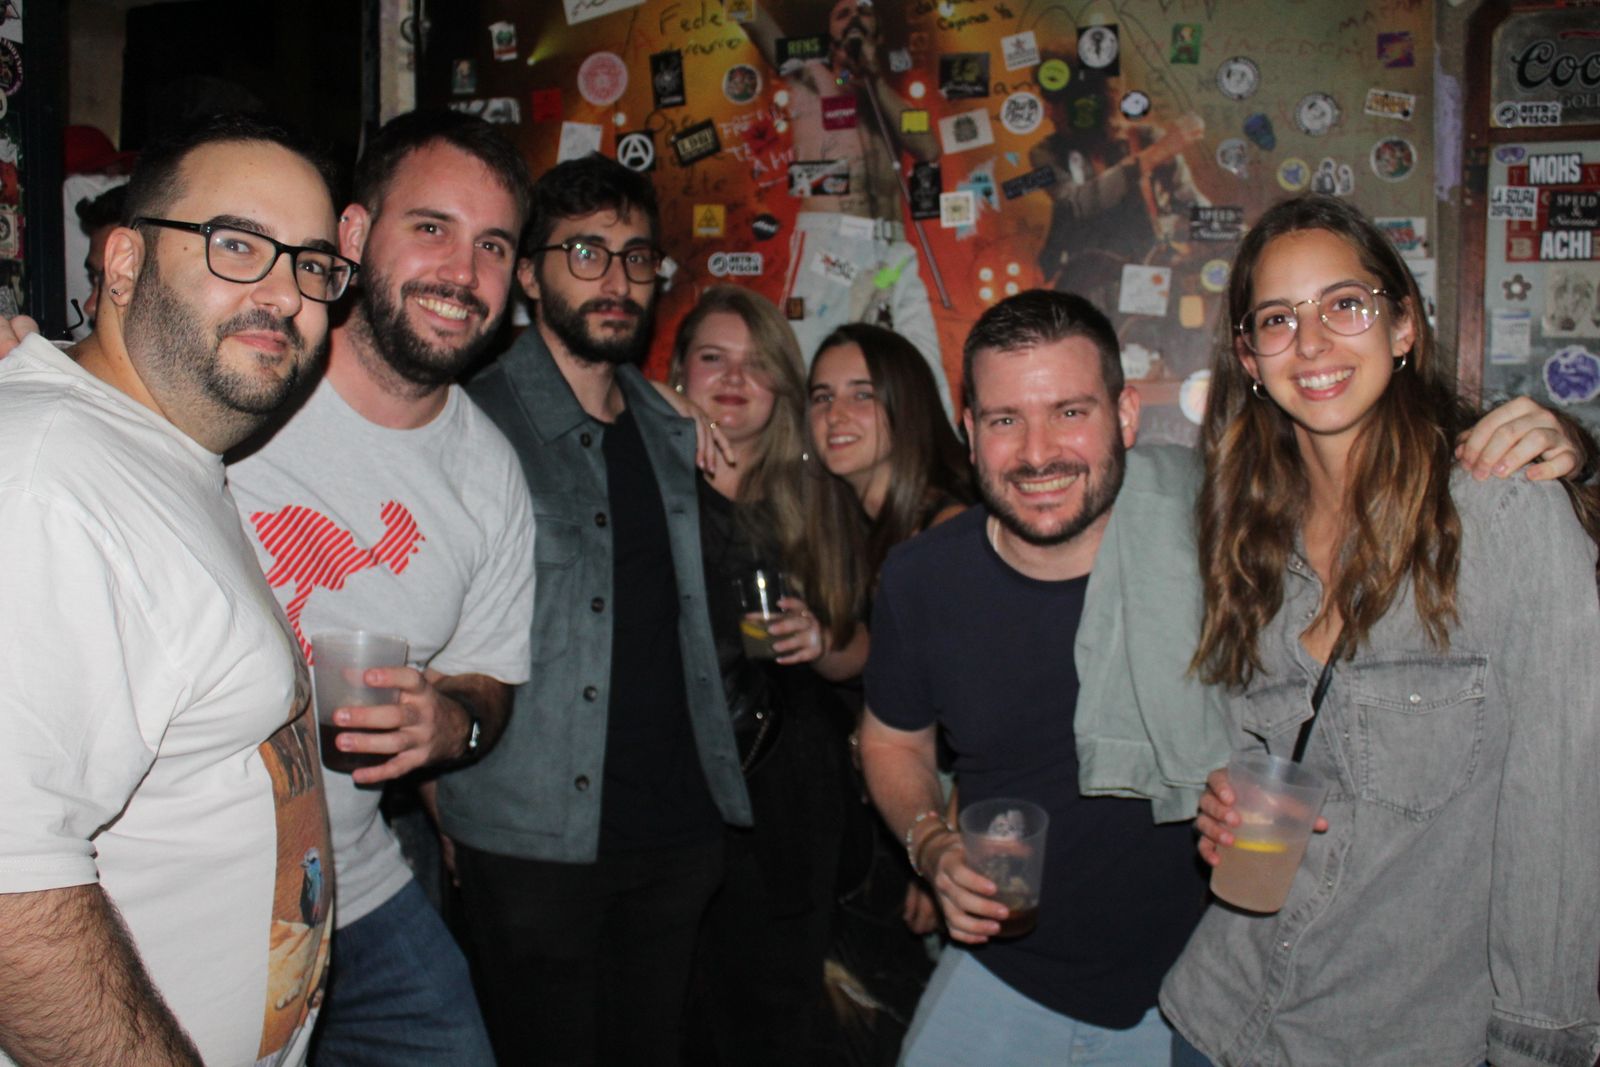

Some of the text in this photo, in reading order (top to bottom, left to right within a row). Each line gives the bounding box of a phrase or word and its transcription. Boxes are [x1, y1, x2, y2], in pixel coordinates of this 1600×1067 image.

[1529, 154, 1581, 185] MOHS
[1556, 194, 1598, 208] SPEED
[1540, 230, 1592, 260] ACHI
